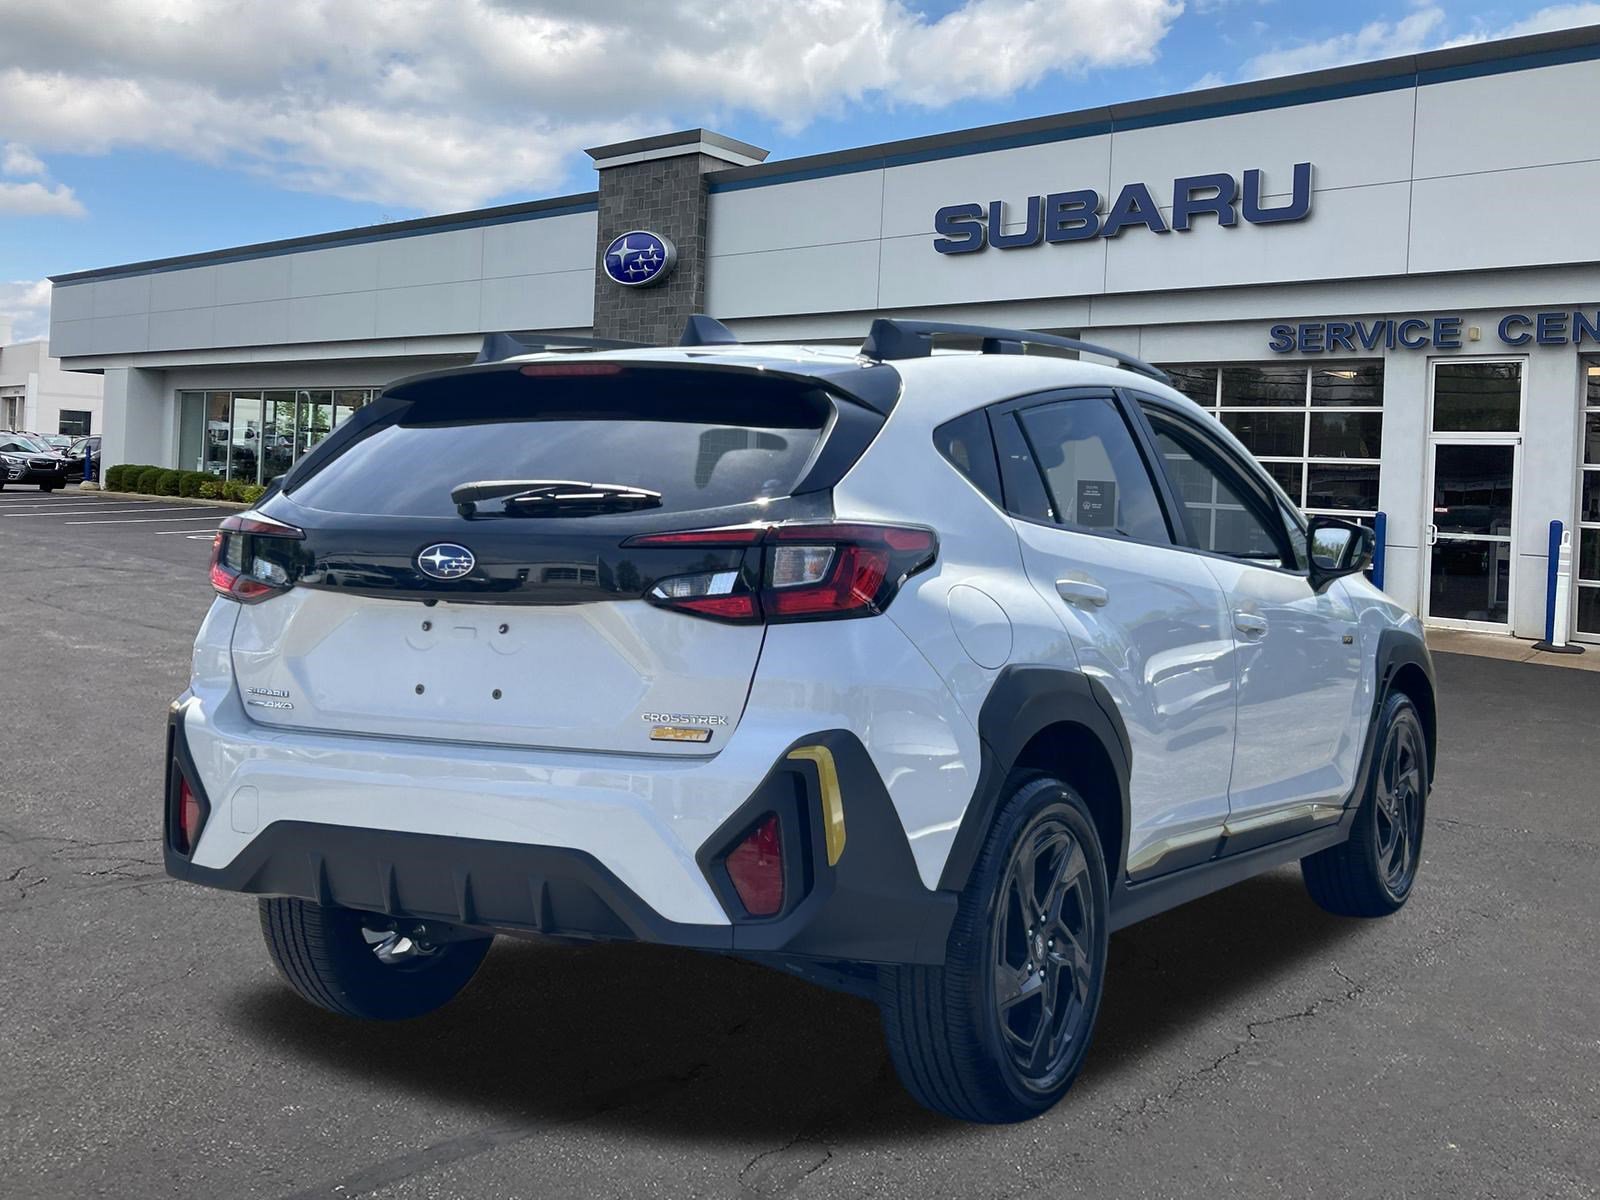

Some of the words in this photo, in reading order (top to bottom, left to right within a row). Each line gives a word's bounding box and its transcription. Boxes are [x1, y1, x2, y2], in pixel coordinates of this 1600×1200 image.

[933, 161, 1313, 255] SUBARU
[1269, 317, 1463, 353] SERVICE
[641, 712, 728, 725] CROSSTREK
